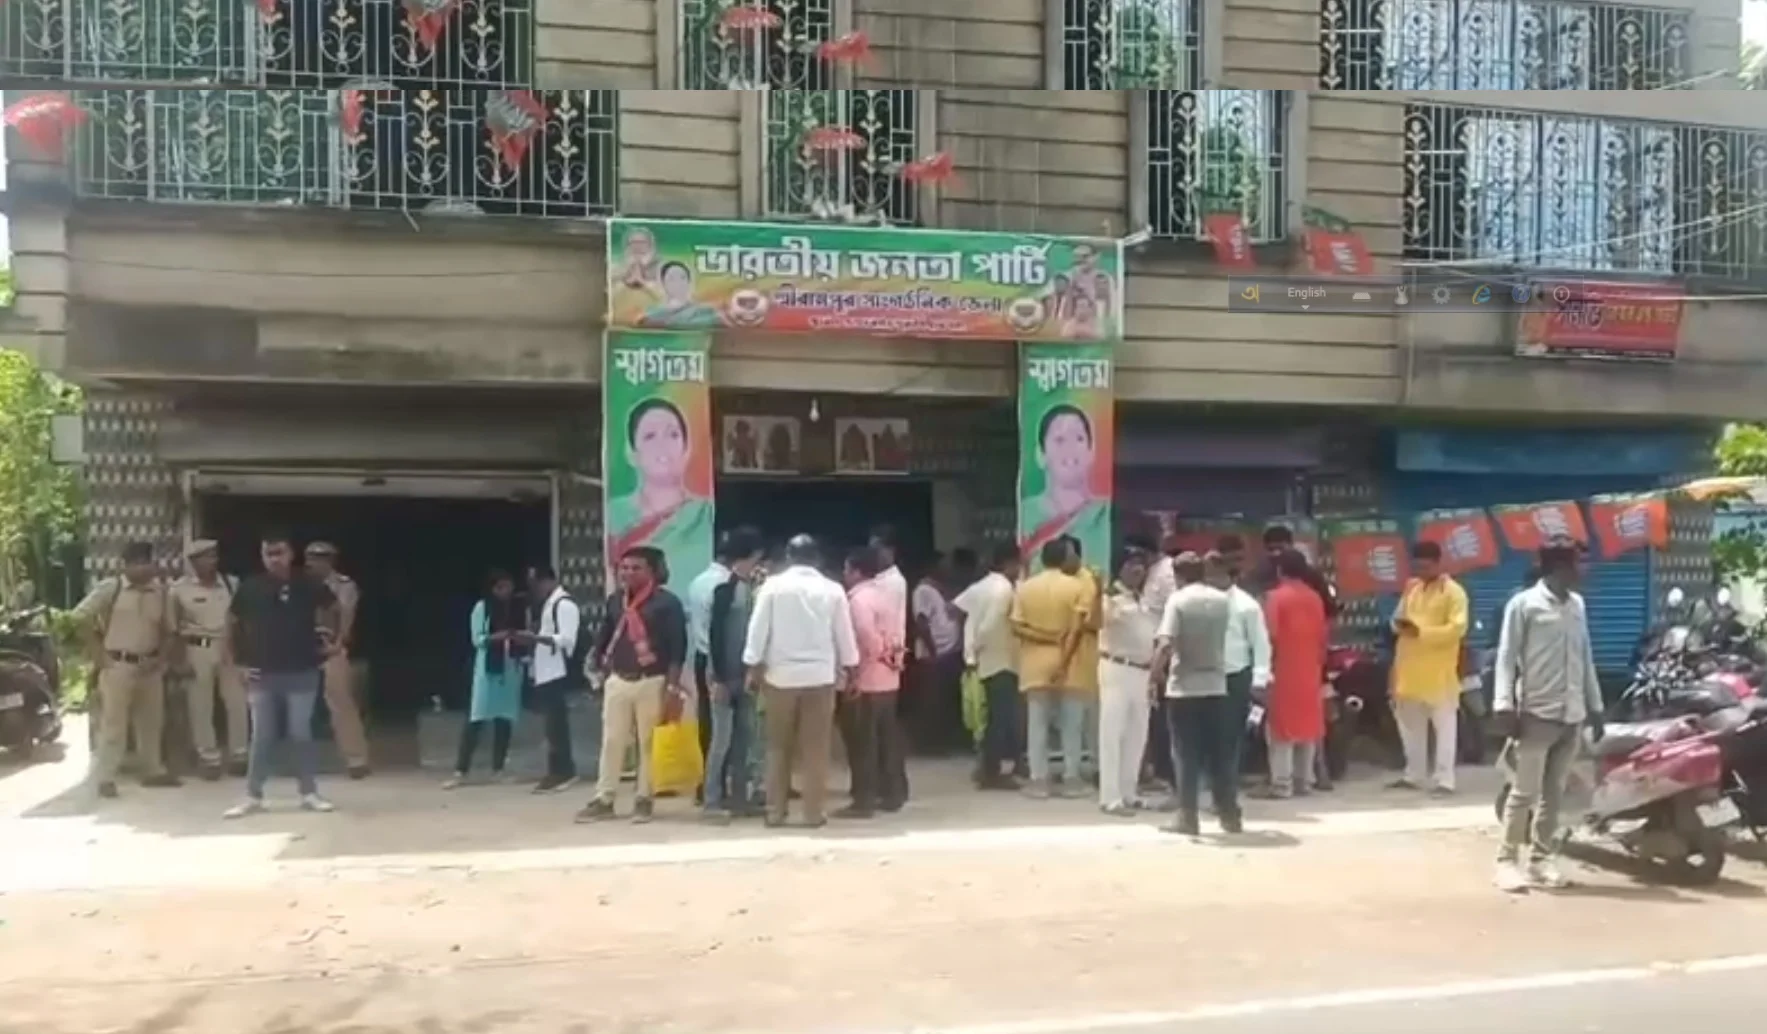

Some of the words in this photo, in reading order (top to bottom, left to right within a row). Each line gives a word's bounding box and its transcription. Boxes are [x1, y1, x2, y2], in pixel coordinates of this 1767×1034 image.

[695, 236, 840, 282] ভারতীয়
[848, 250, 962, 281] জনতা
[971, 241, 1052, 286] পার্টি
[613, 347, 705, 386] স্বাগতম
[1027, 357, 1110, 392] স্বাগতম
